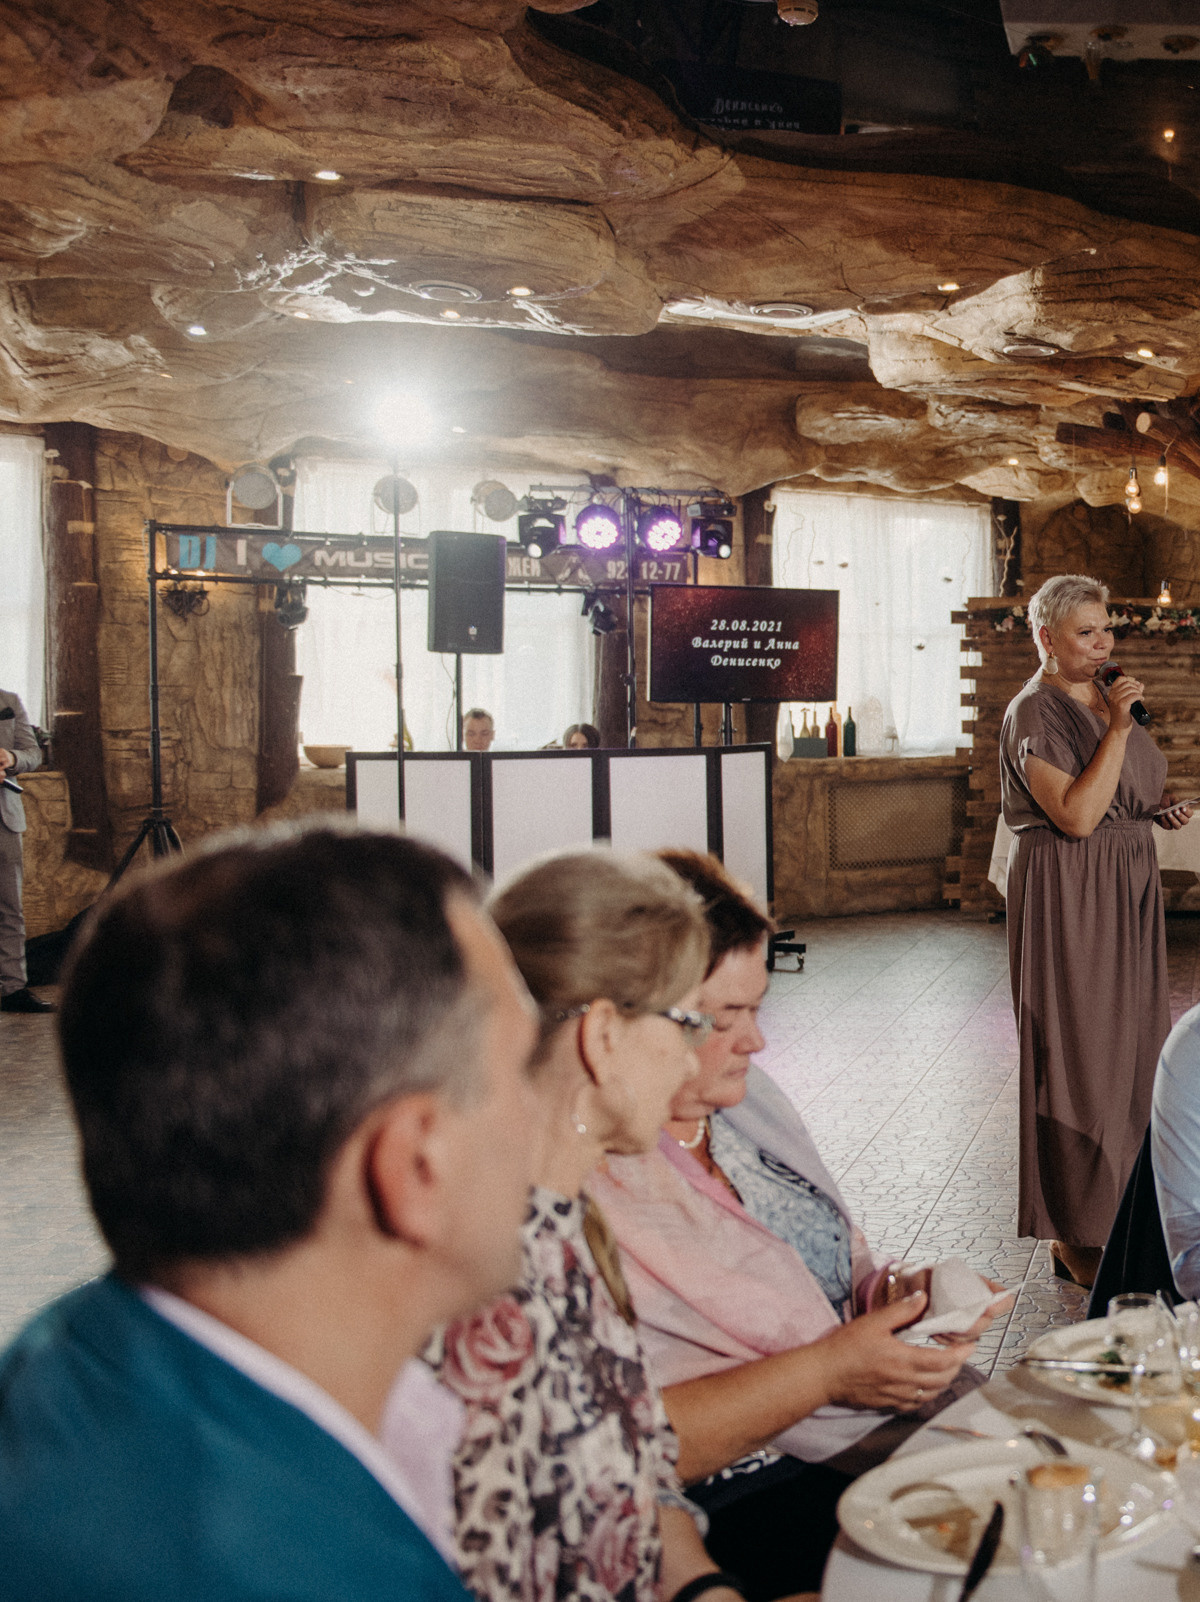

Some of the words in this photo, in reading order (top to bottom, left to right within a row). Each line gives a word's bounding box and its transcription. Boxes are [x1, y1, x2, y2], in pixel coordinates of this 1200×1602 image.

[179, 534, 217, 569] DJ
[236, 539, 247, 566] I
[313, 549, 430, 569] MUSIC
[711, 619, 783, 632] 28.08.2021
[691, 636, 749, 652] Валерий
[753, 640, 761, 649] и
[764, 638, 800, 651] Анна
[711, 655, 782, 669] Денисенко
